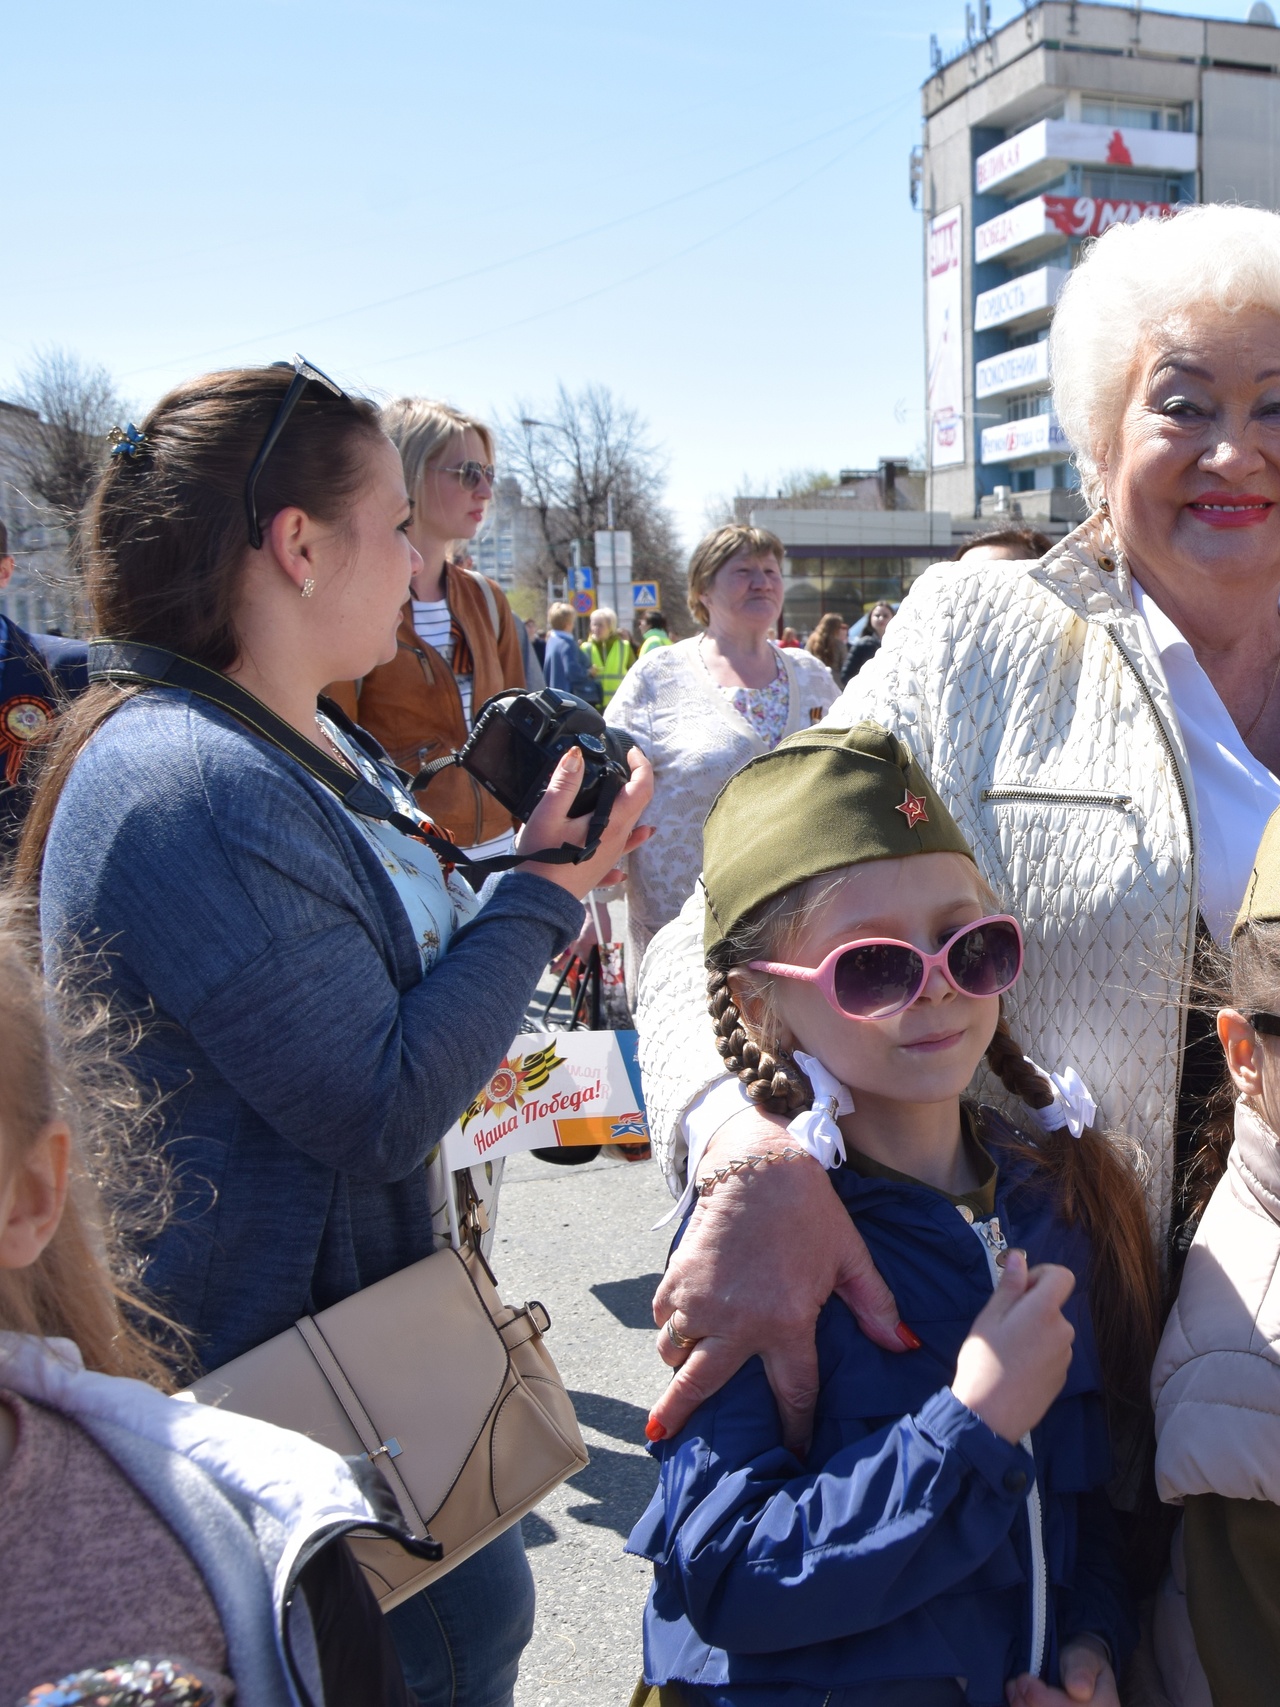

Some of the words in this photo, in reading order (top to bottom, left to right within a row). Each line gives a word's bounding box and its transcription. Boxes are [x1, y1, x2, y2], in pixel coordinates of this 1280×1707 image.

[977, 143, 1020, 185] ВЕЛИКАЯ
[1072, 197, 1096, 234] 9
[978, 285, 1025, 321] ГОРДОСТЬ
[979, 348, 1038, 390] ПОКОЛЕНИЙ
[473, 1115, 519, 1156] Наша
[521, 1079, 601, 1125] Победа!
